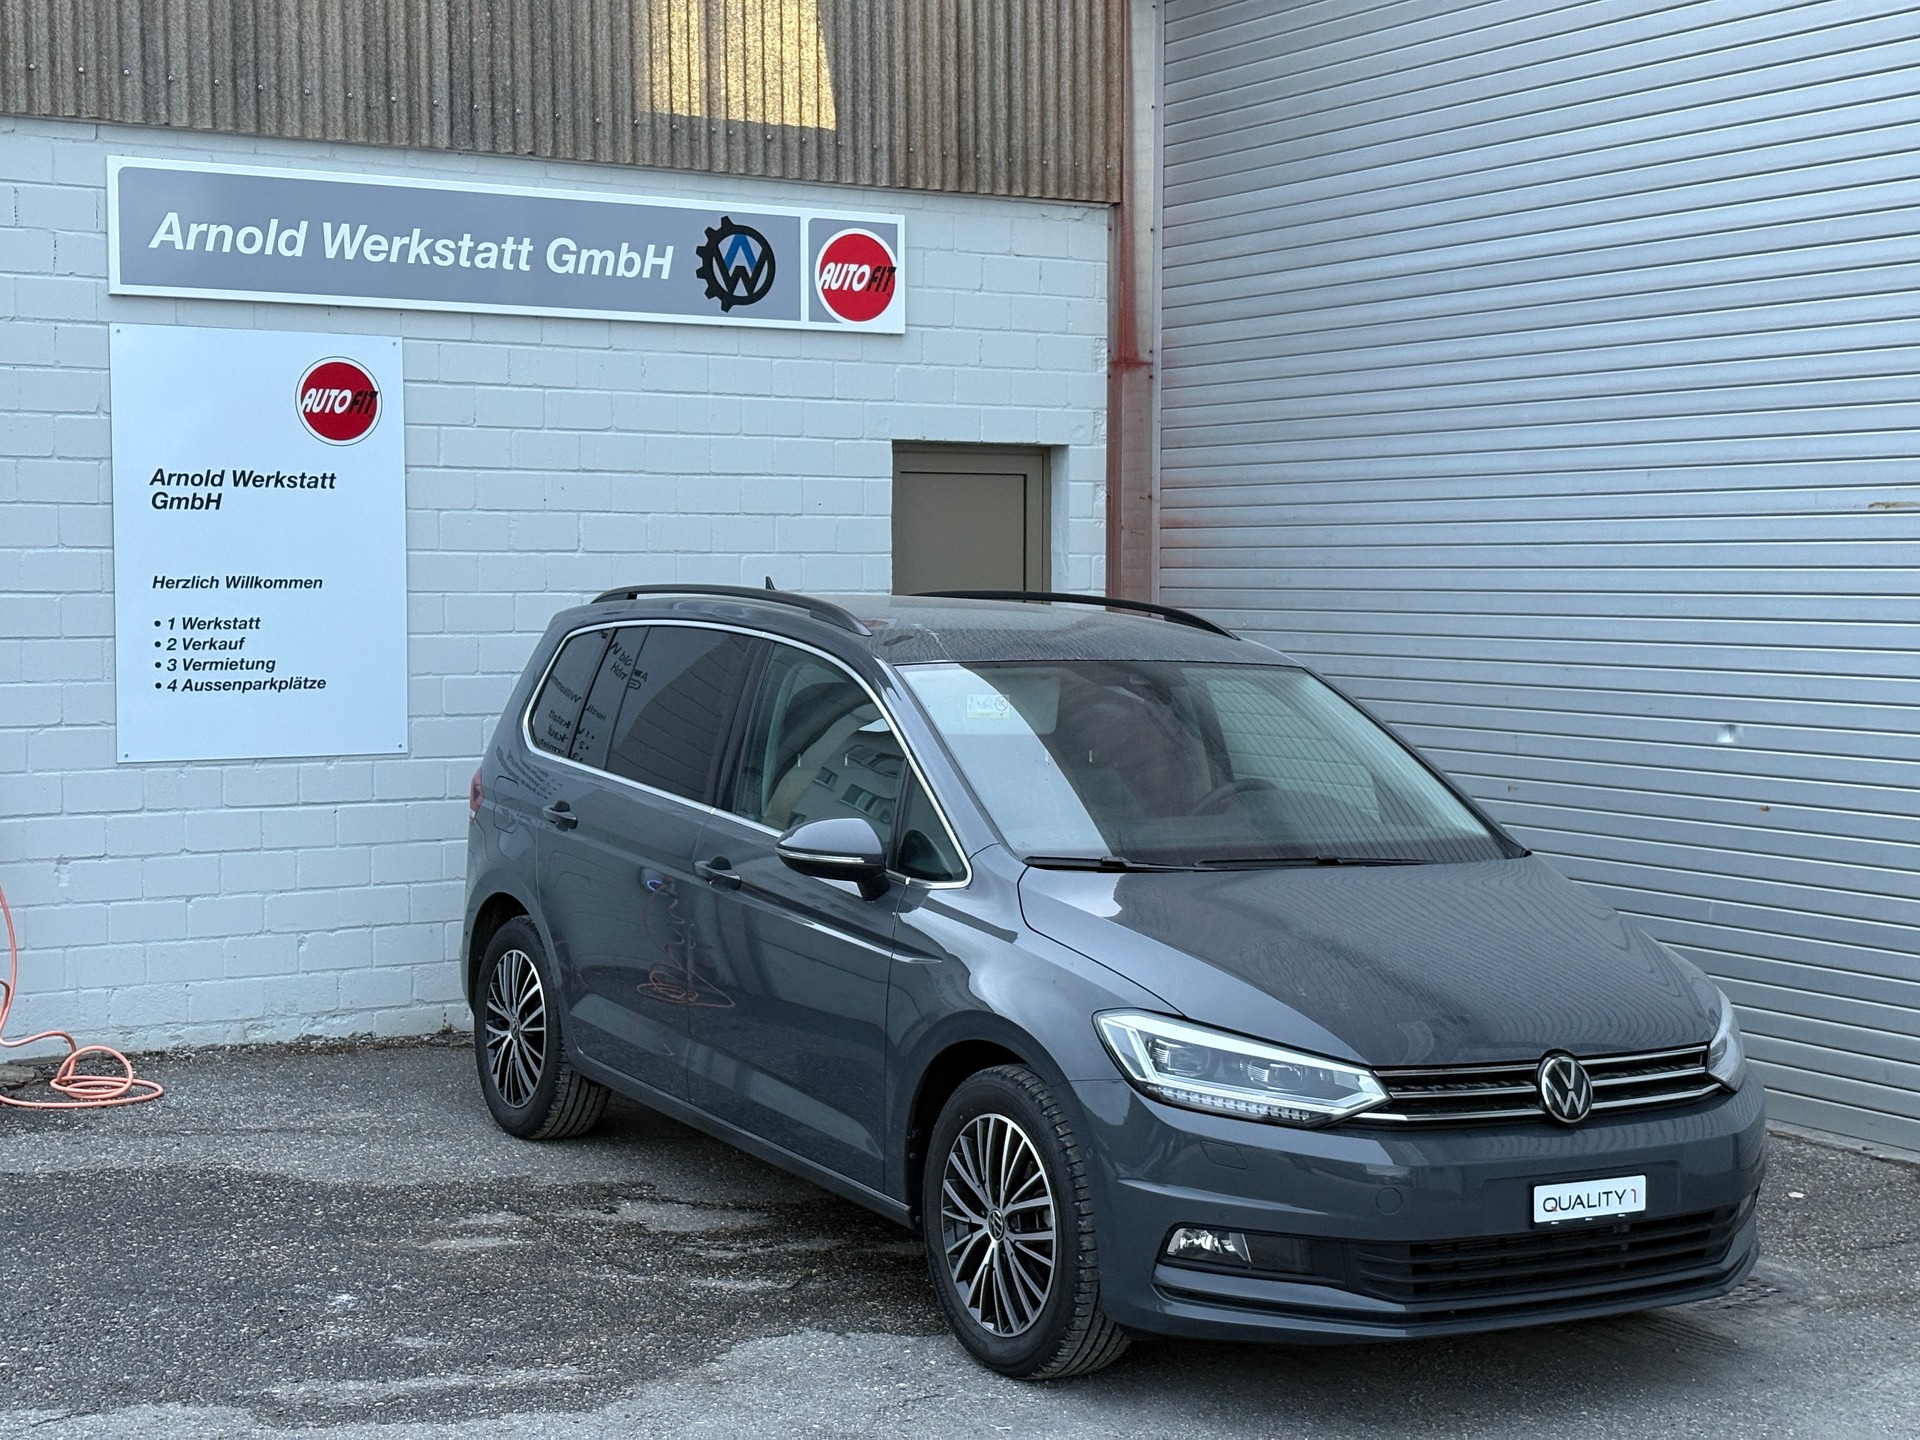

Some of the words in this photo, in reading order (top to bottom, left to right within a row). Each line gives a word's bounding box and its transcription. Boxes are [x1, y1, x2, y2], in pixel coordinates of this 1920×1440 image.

[149, 212, 308, 257] Arnold
[323, 222, 533, 271] Werkstatt
[546, 237, 674, 279] GmbH
[149, 468, 225, 487] Arnold
[232, 470, 336, 489] Werkstatt
[151, 492, 222, 510] GmbH
[152, 575, 220, 589] Herzlich
[225, 575, 323, 589] Willkommen
[168, 617, 176, 630] 1
[182, 617, 261, 630] Werkstatt
[166, 638, 177, 651] 2
[182, 637, 246, 651] Verkauf
[166, 658, 177, 672] 3
[182, 657, 276, 673] Vermietung
[167, 679, 178, 692] 4
[181, 676, 327, 693] Aussenparkplätze
[1542, 1189, 1627, 1212] QUALITY
[1630, 1188, 1637, 1204] 1
